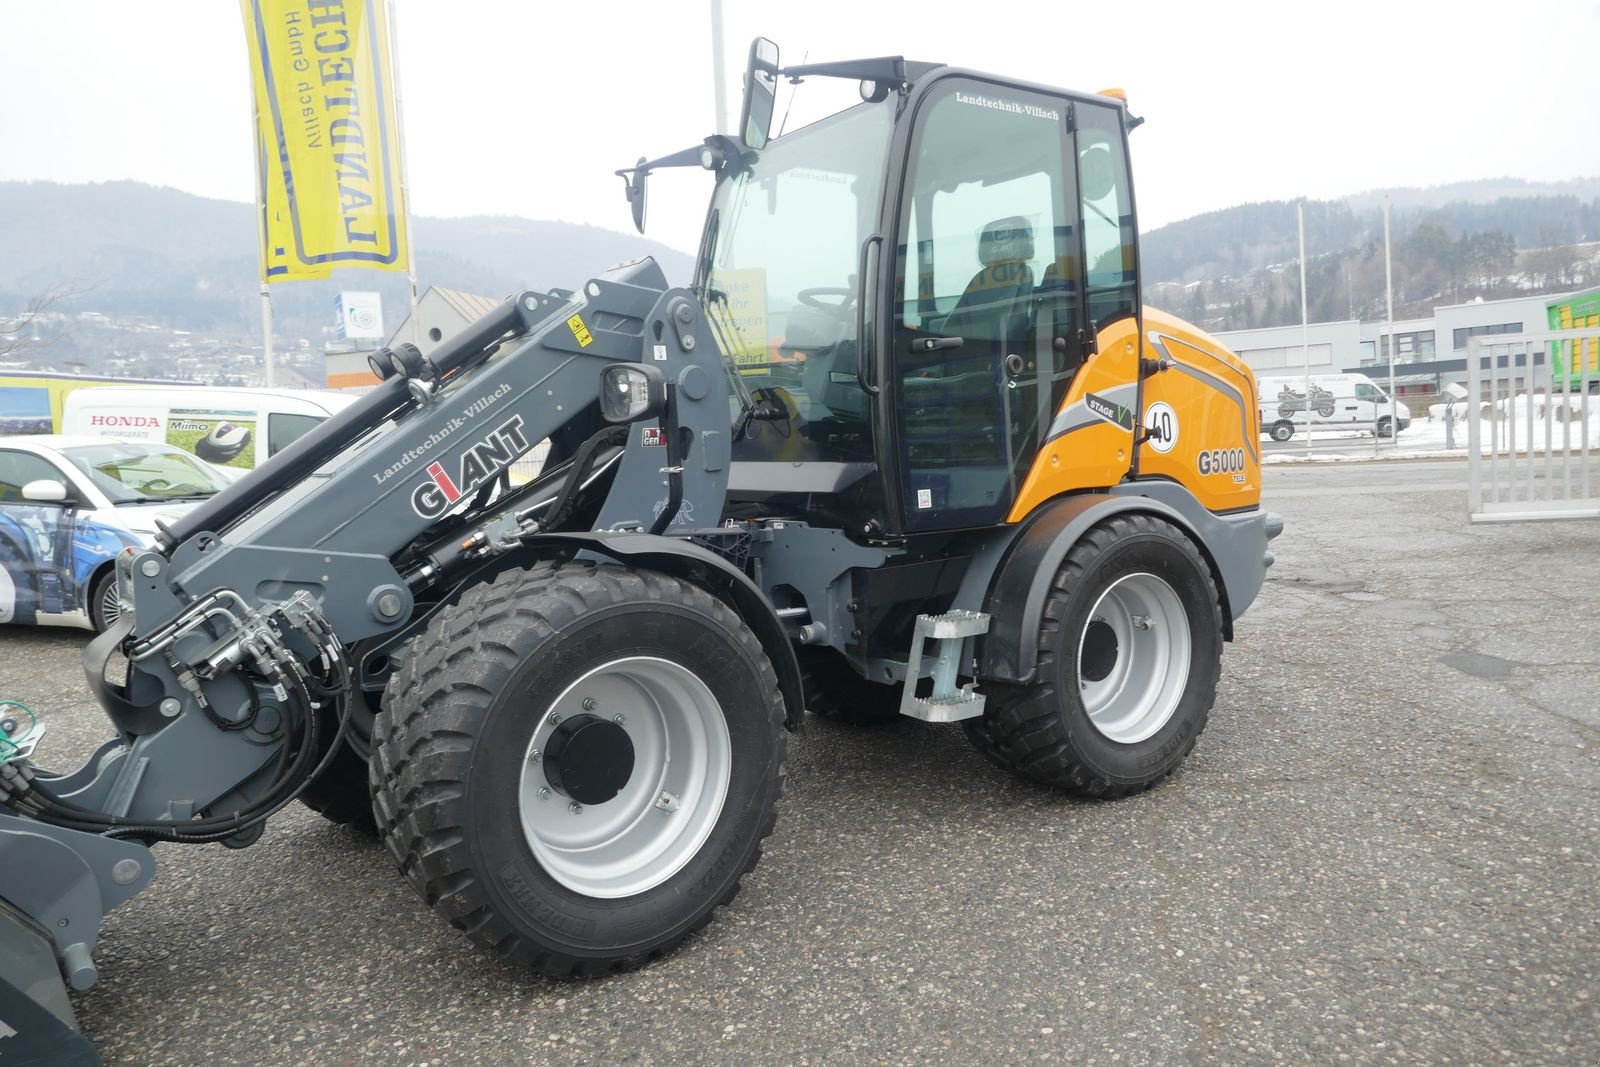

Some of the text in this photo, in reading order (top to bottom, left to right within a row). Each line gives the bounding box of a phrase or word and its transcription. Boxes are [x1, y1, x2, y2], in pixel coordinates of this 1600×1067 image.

[955, 92, 1060, 121] Landtechnik-Villach
[91, 415, 161, 428] HONDA
[1089, 399, 1115, 419] STAGE
[170, 419, 209, 432] Miimo
[372, 382, 513, 485] Landtechnik-Villach
[1151, 411, 1172, 443] 40
[1198, 448, 1245, 476] G5000
